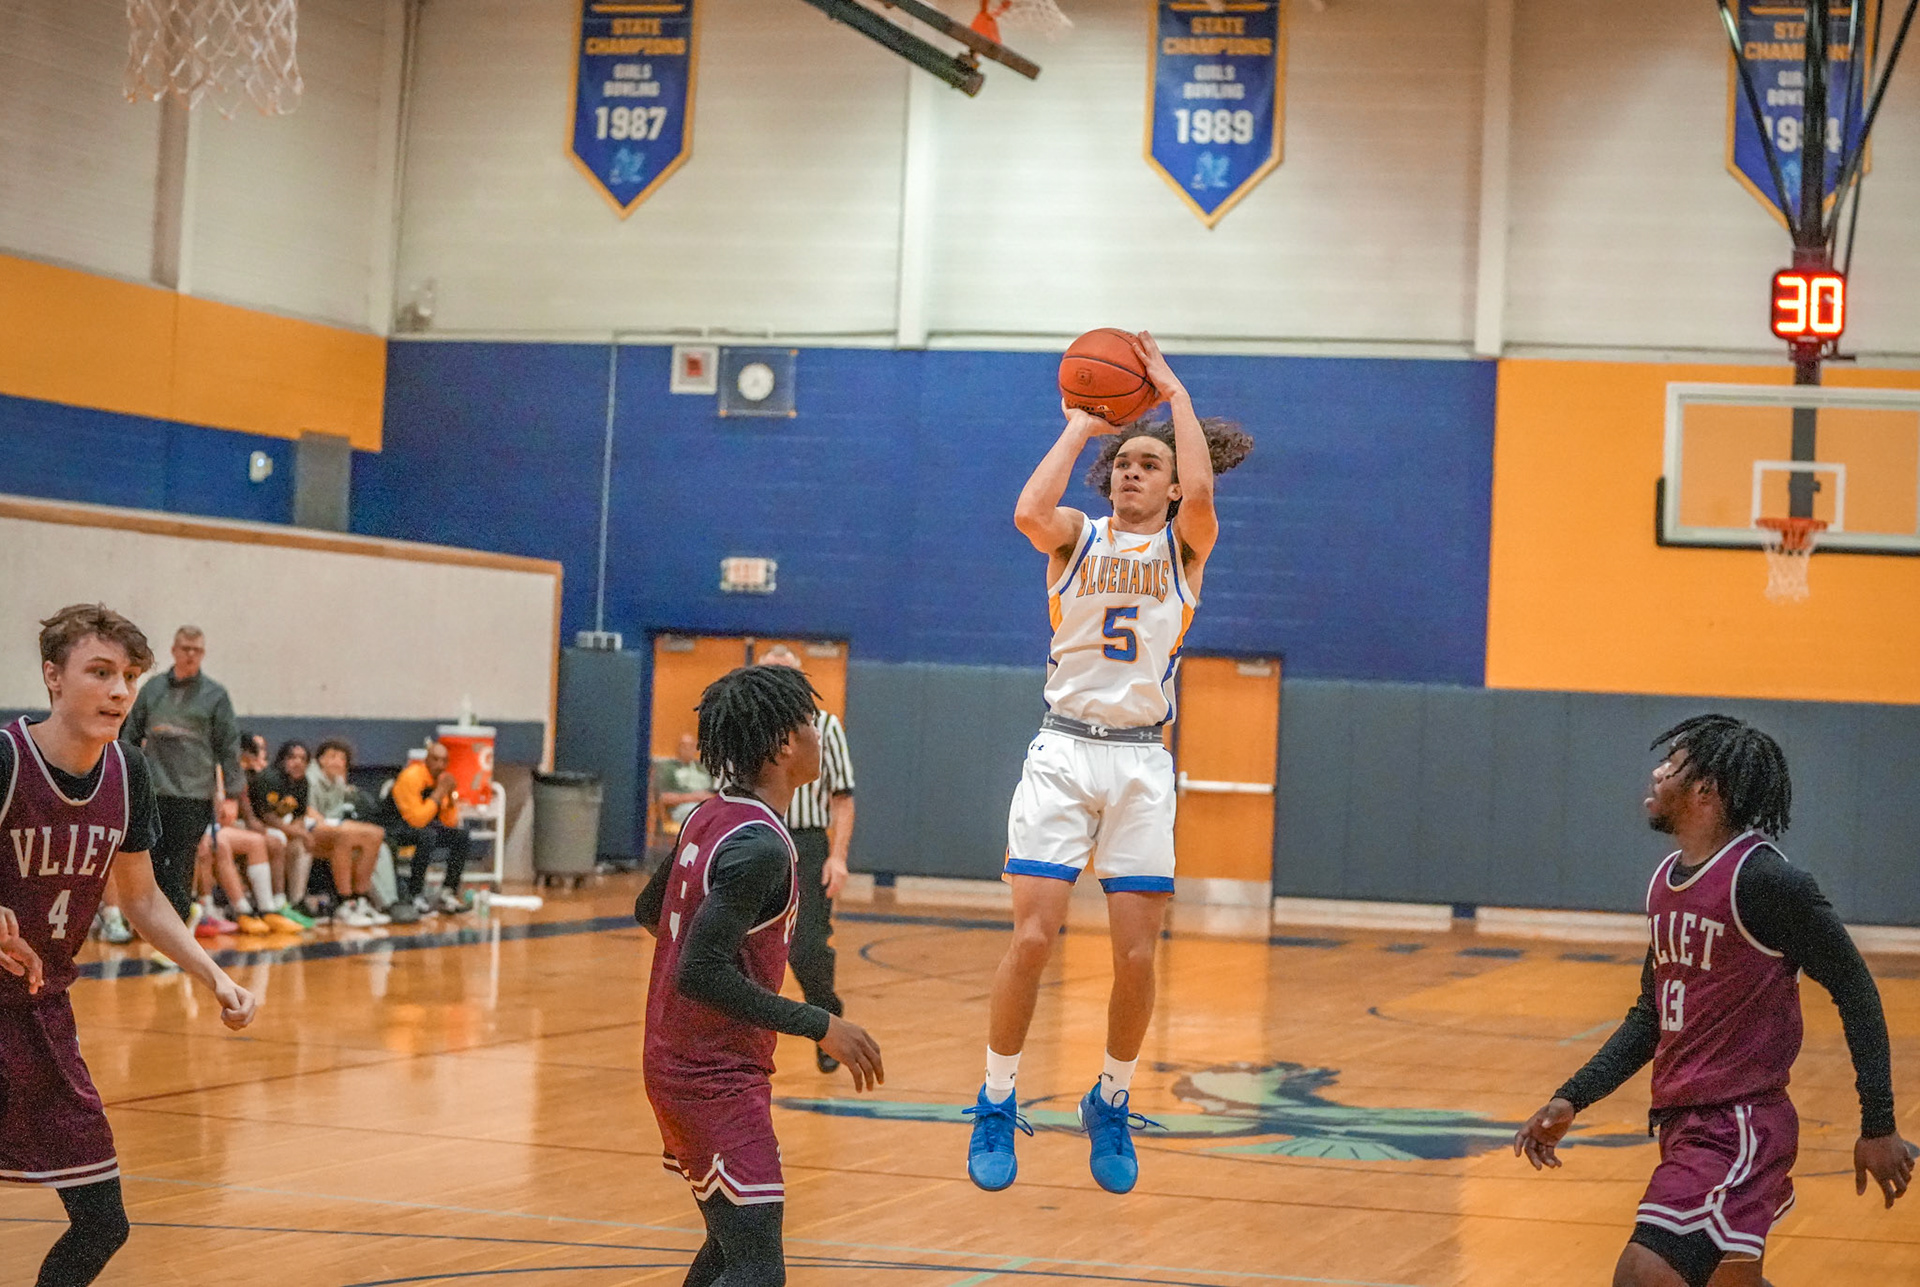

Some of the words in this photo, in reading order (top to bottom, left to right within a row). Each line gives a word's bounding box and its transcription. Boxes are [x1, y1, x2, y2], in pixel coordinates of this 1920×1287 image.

[1191, 17, 1245, 34] STATE
[595, 106, 667, 140] 1987
[1174, 109, 1254, 144] 1989
[1776, 276, 1843, 333] 30
[1101, 604, 1140, 665] 5
[10, 824, 122, 879] VLIET
[48, 889, 72, 940] 4
[1661, 978, 1686, 1032] 13
